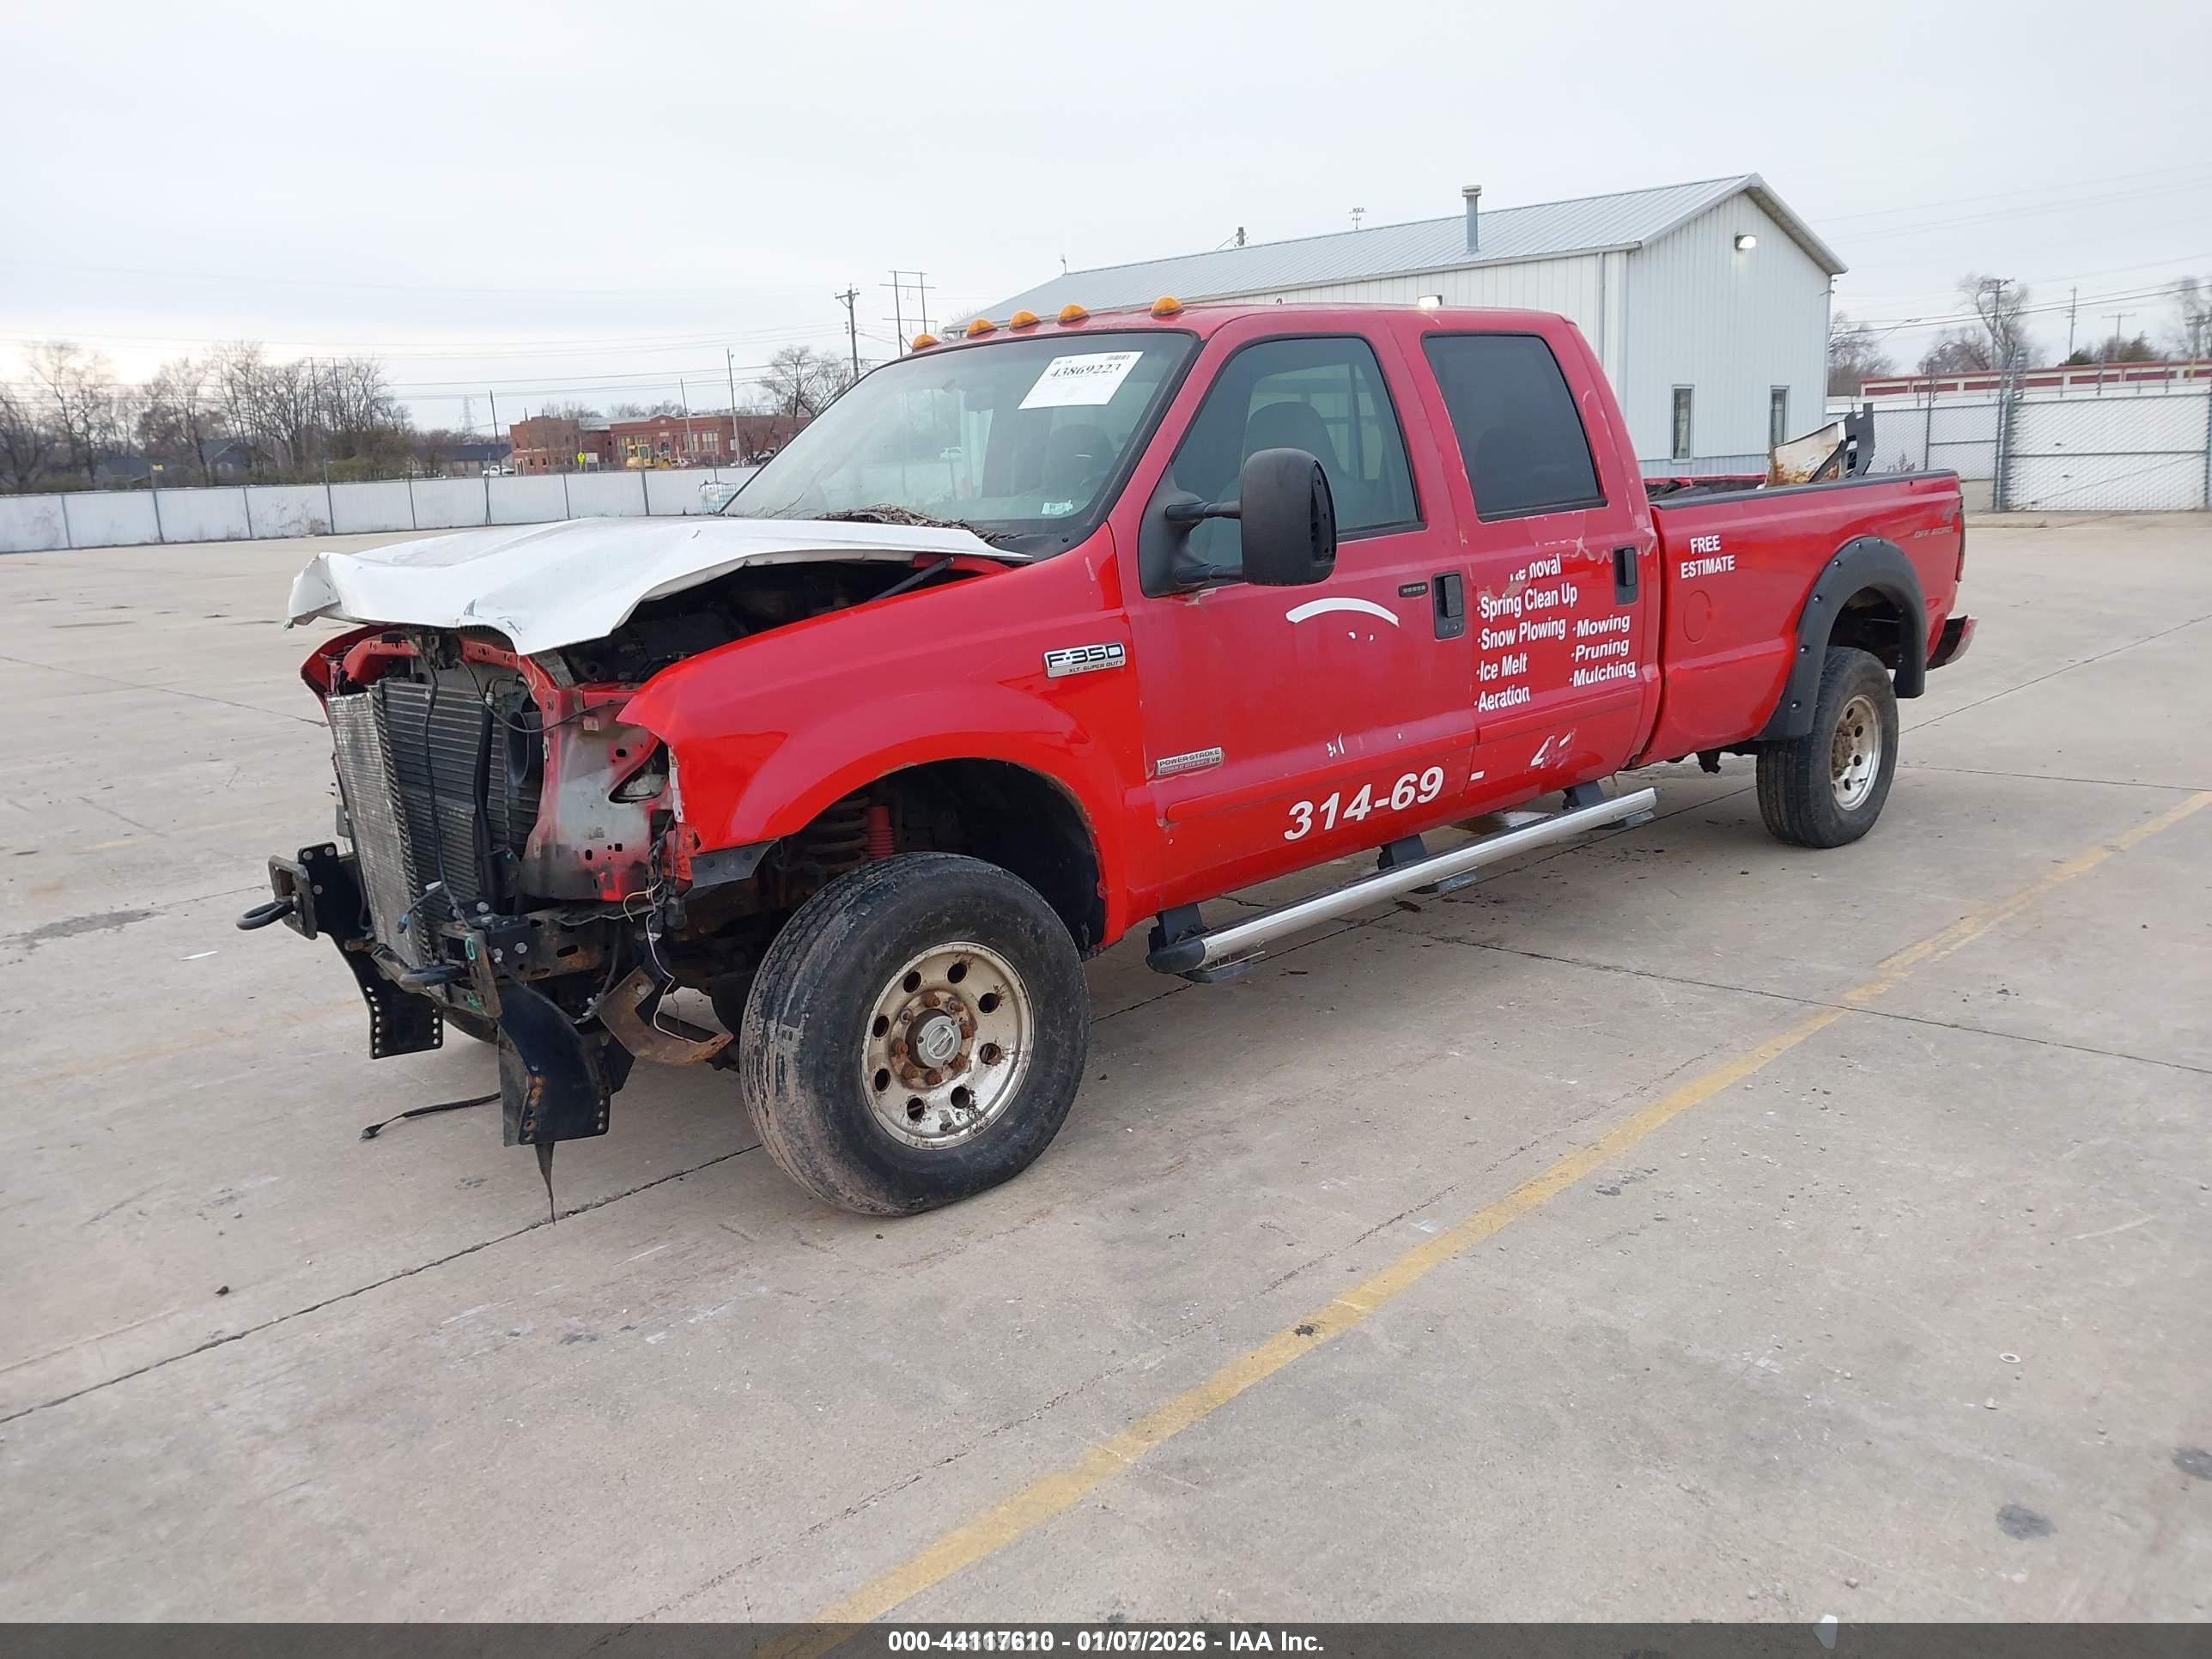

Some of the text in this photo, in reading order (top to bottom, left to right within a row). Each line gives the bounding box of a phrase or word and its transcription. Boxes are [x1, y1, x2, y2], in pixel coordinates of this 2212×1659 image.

[1050, 363, 1121, 378] 43869223
[1690, 535, 1721, 555] FREE
[1680, 555, 1735, 579] ESTIMATE
[1480, 582, 1577, 623] Spring Clean Up
[1480, 616, 1566, 650] Snow Plowing
[1577, 614, 1631, 637] Mowing
[1047, 644, 1123, 668] F-350
[1575, 638, 1629, 662] Pruning
[1480, 653, 1528, 681] Ice Melt
[1573, 660, 1636, 687] Mulching
[1478, 684, 1531, 712] Aeration
